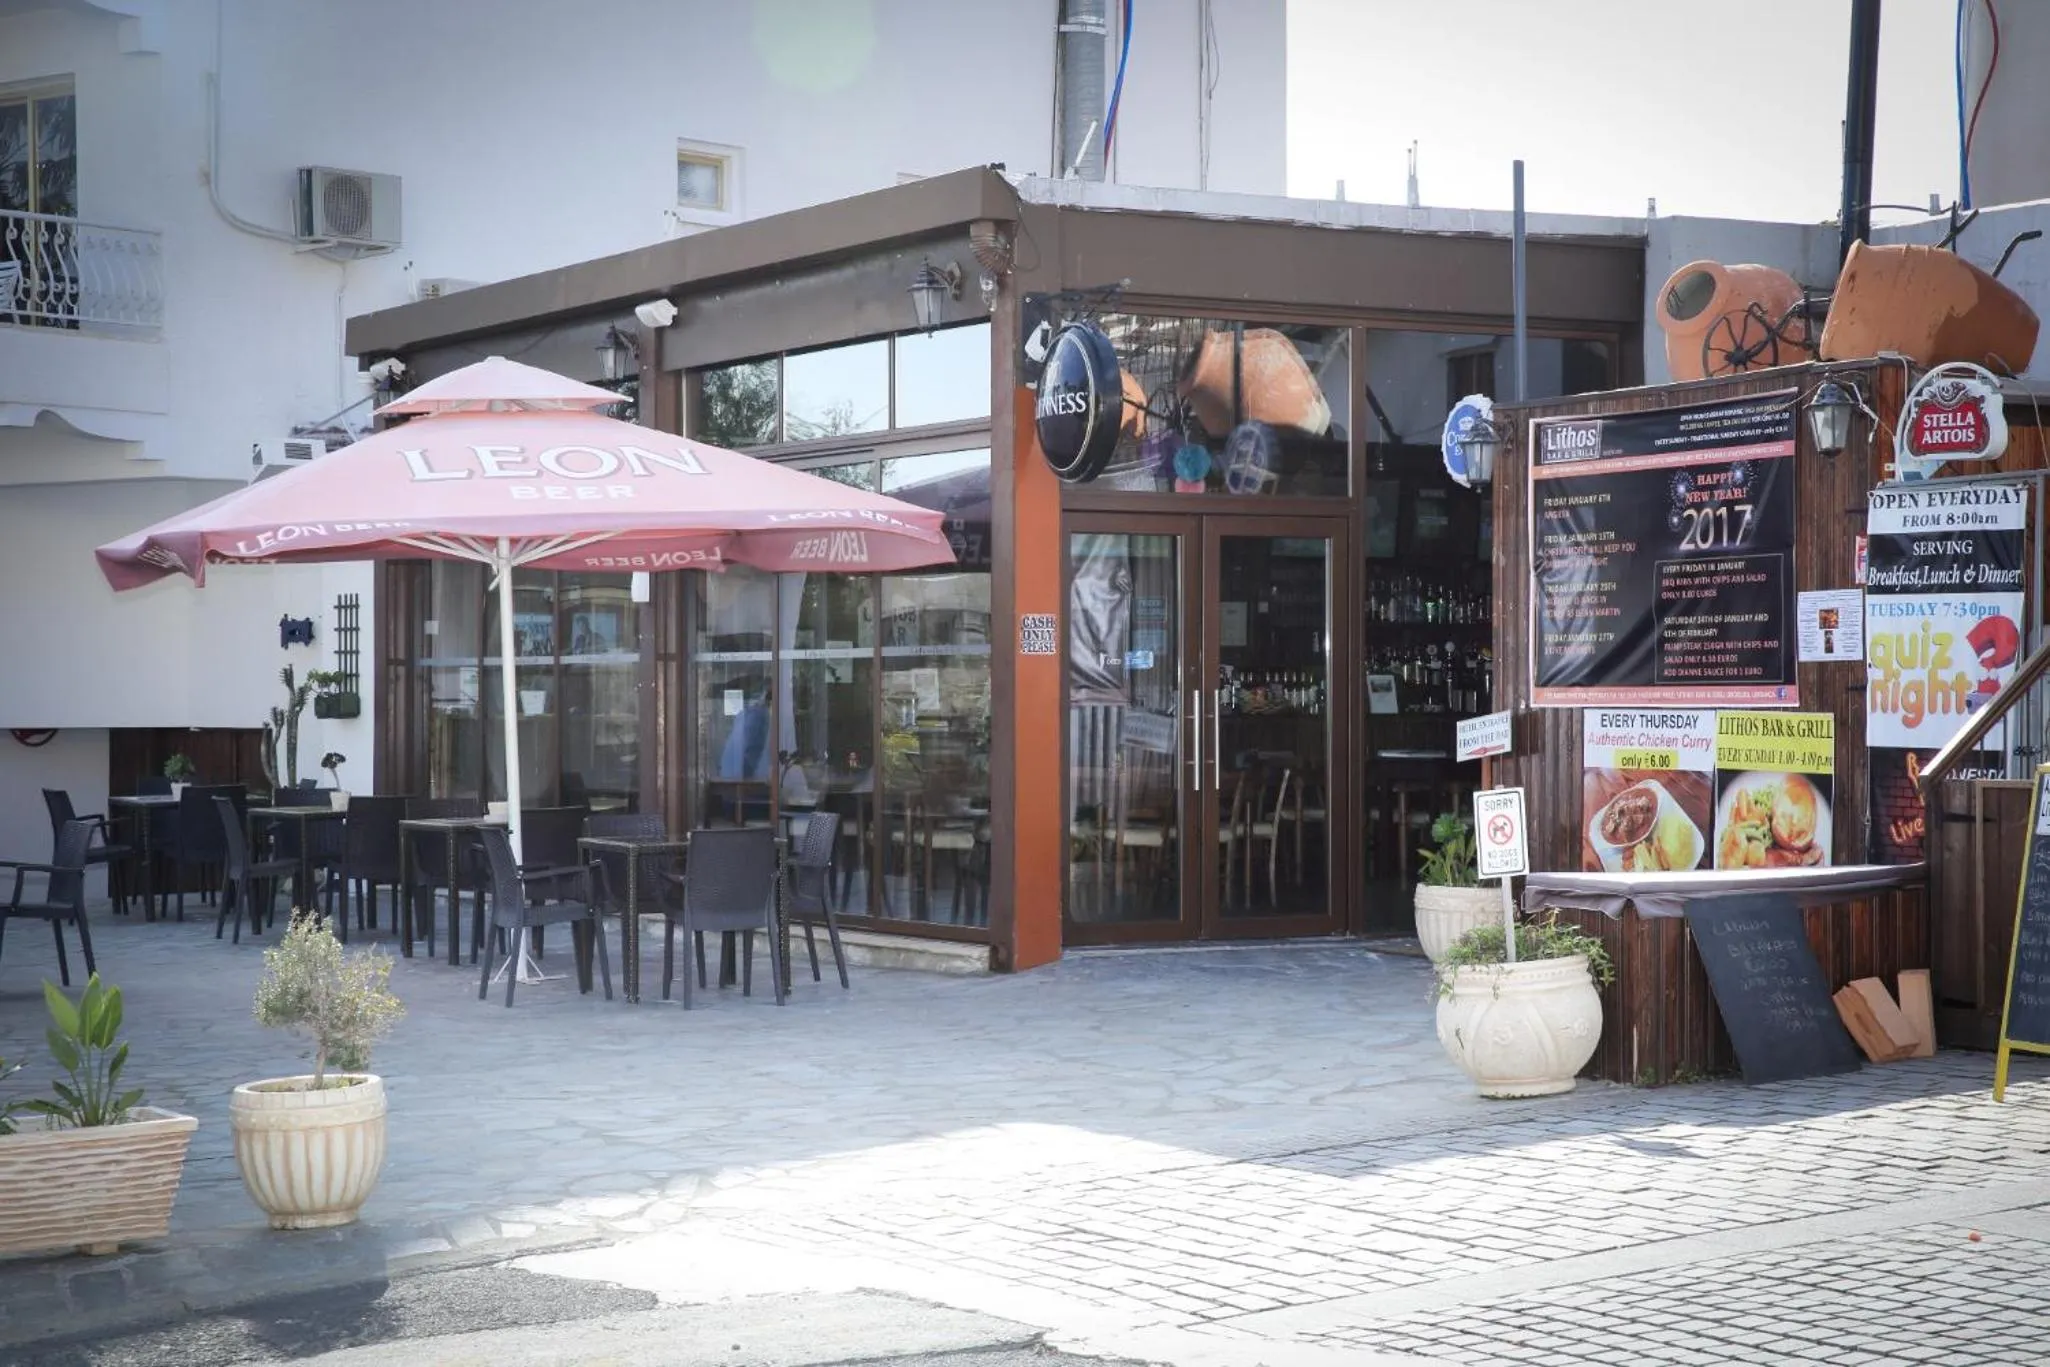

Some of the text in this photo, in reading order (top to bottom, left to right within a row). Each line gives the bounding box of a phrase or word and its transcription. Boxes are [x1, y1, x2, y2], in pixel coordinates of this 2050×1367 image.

[1923, 411, 1976, 428] STELLA
[1547, 426, 1597, 450] Lithos
[1922, 428, 1976, 445] ARTOIS
[400, 445, 711, 480] LEON
[1697, 472, 1734, 485] HAPPY
[510, 484, 636, 500] BEER
[1686, 491, 1712, 503] NEW
[1872, 488, 2022, 510] OPEN EVERYDAY
[1680, 503, 1753, 550] 2017
[1902, 512, 1998, 527] FROM 8:00am
[236, 524, 331, 555] LEON
[1912, 540, 1973, 556] SERVING
[1682, 563, 1706, 572] FRIDAY
[1717, 561, 1745, 571] JANUARY
[1978, 563, 2021, 584] Dinner
[1870, 602, 2001, 619] TUESDAY 7:30pm
[1023, 616, 1055, 629] CASH
[1023, 629, 1053, 641] ONLY
[1869, 619, 1954, 676] quiz
[1870, 666, 1973, 729] night
[1601, 713, 1699, 729] EVERY THURSDAY
[1718, 717, 1833, 739] LITHOS BAR & GRILL
[1588, 731, 1712, 752] Authentic Chicken Curry
[1621, 754, 1642, 768] only
[1717, 747, 1742, 762] EVERY
[1744, 748, 1775, 763] SUNDAY
[1485, 798, 1514, 811] SORRY
[1890, 818, 1925, 842] Live
